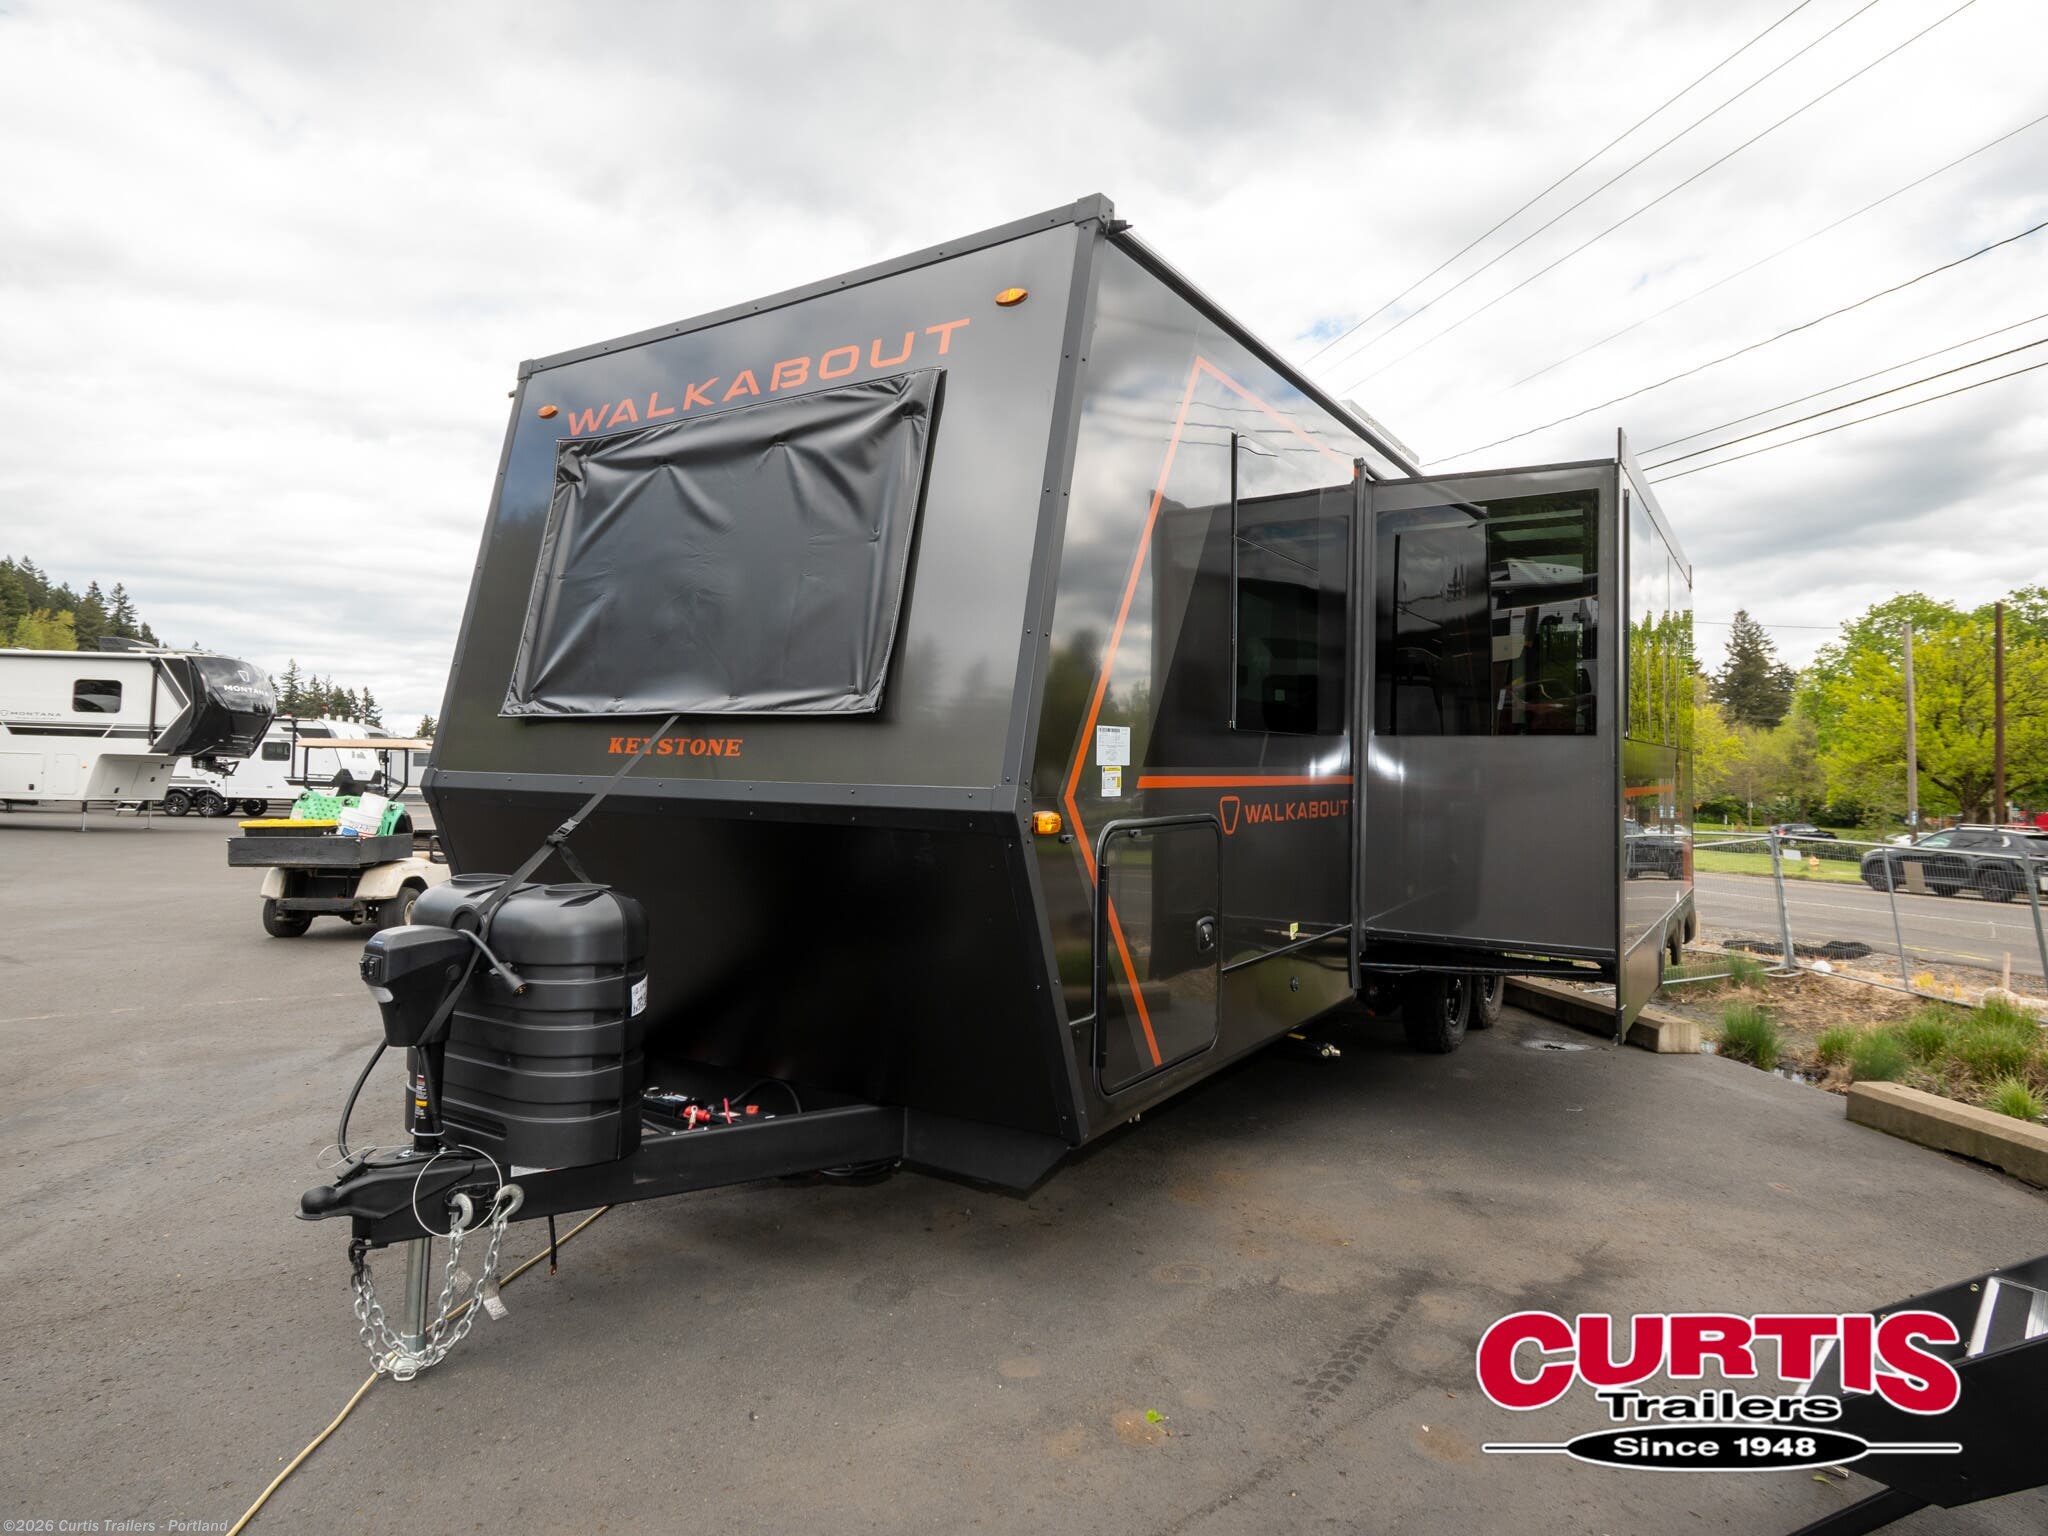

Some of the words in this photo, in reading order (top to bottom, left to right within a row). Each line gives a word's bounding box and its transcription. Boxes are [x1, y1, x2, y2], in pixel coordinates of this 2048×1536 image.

[568, 318, 971, 436] WALKABOUT
[223, 684, 270, 697] MONTANA
[1244, 799, 1349, 824] WALKABOUT
